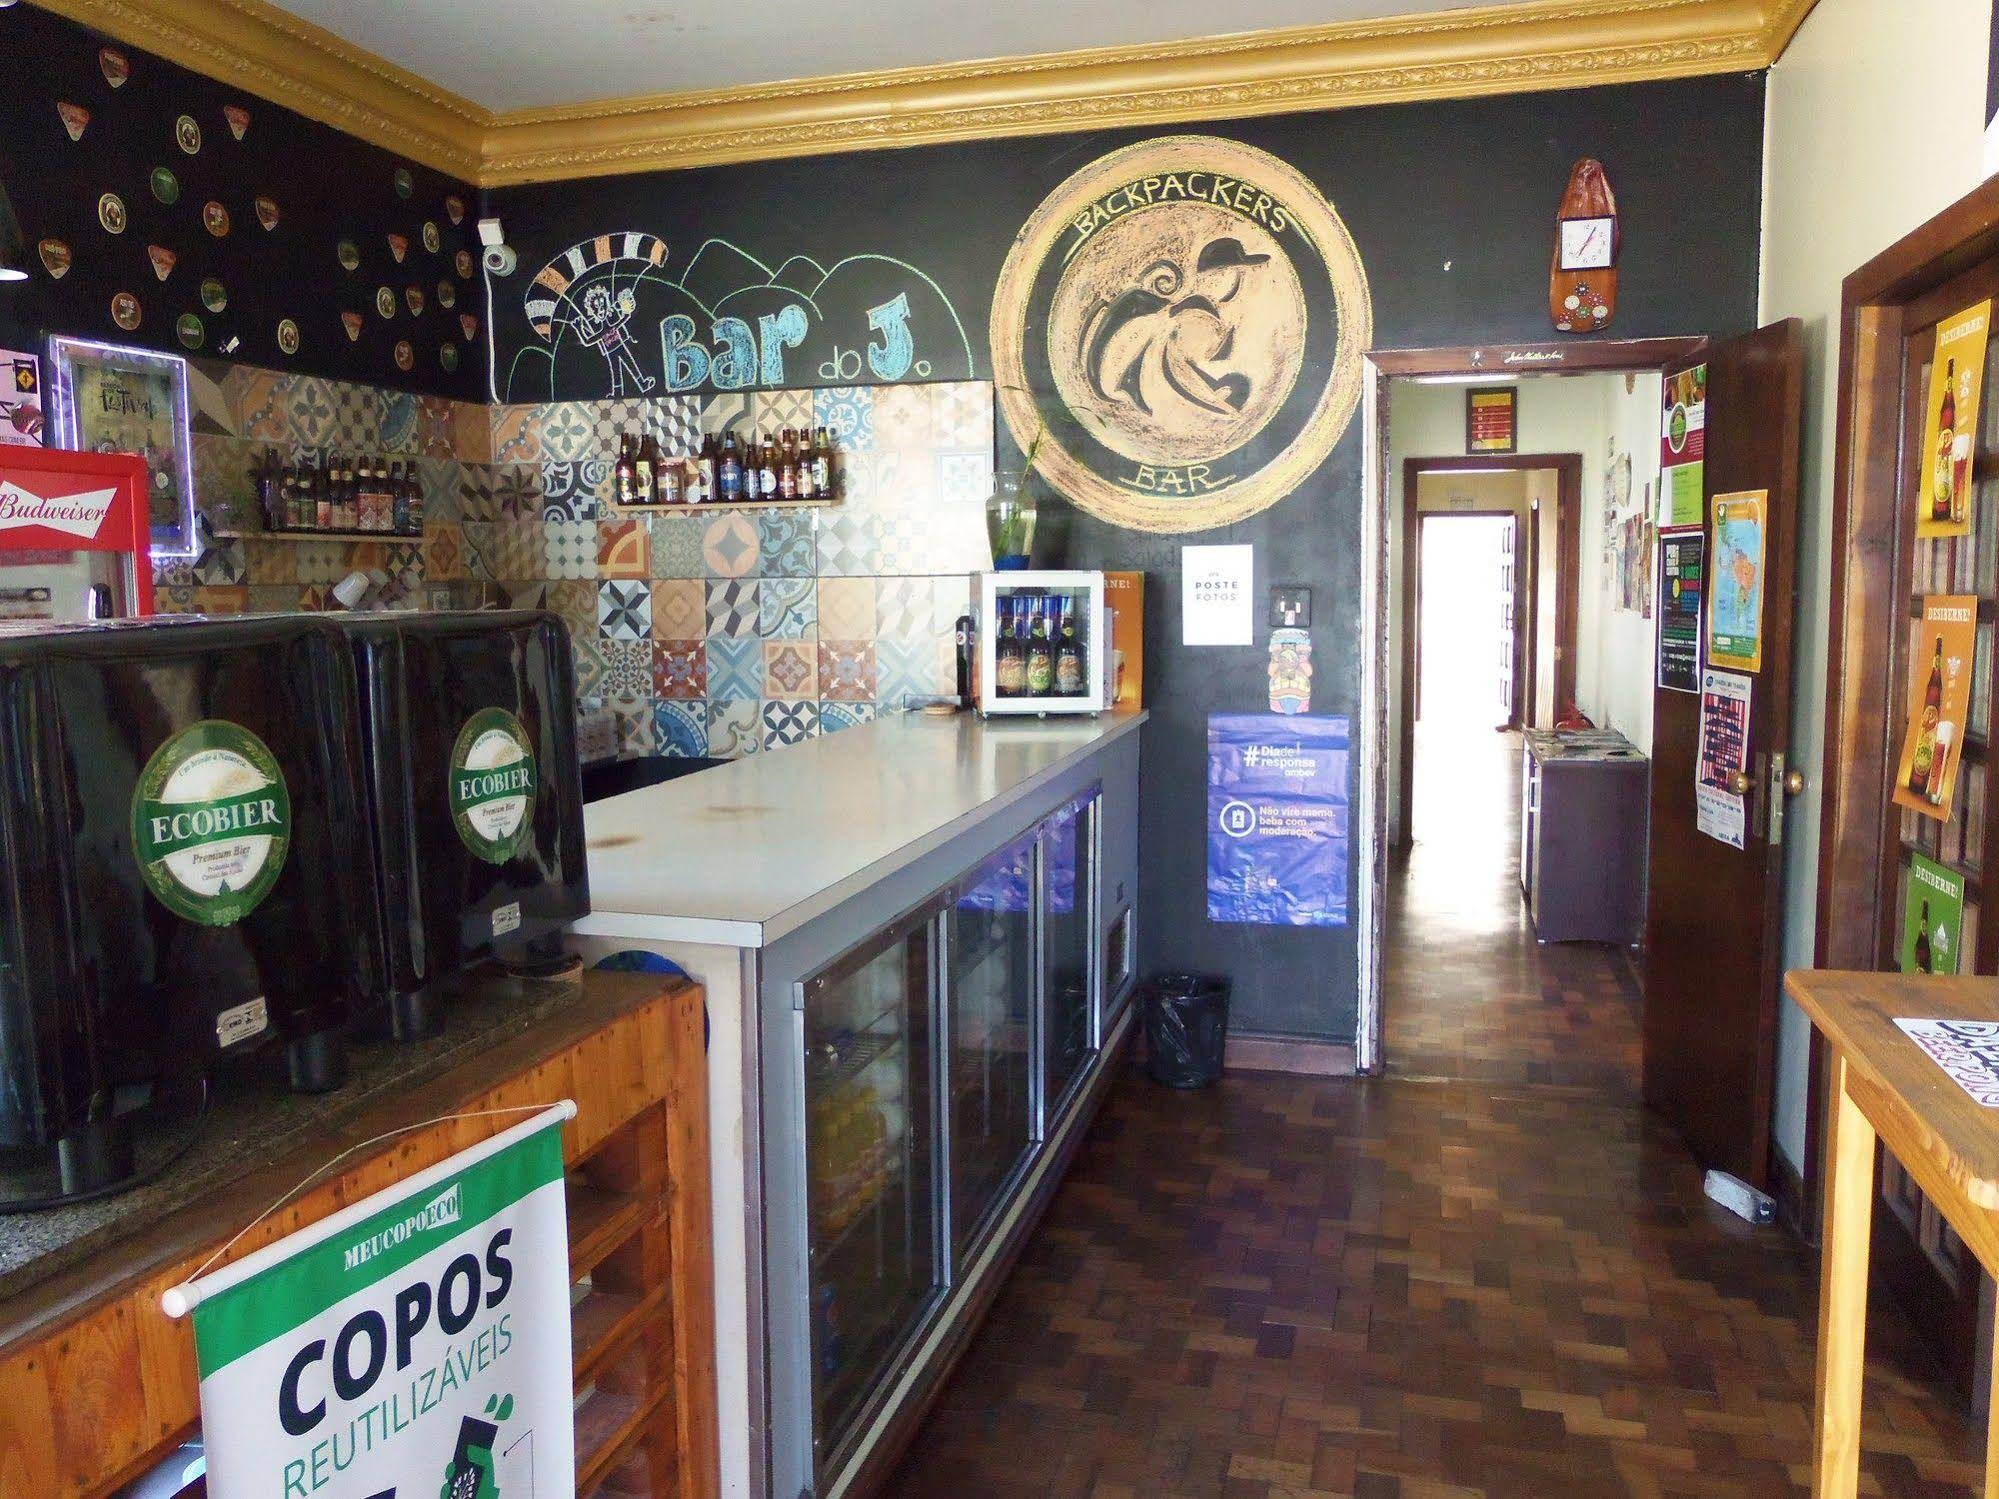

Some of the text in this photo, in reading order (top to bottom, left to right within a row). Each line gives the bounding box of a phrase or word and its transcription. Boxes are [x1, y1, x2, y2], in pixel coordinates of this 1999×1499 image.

[1073, 173, 1286, 235] BACKPACKERS
[660, 304, 808, 393] Bar
[818, 345, 861, 380] do
[1131, 464, 1218, 494] BAR
[0, 494, 106, 520] Budweiser
[1195, 581, 1238, 589] POSTE
[1196, 593, 1237, 601] FOTOS
[1928, 607, 1971, 622] DESIBERNE!
[1261, 758, 1316, 769] responsa
[460, 767, 533, 800] ECOBIER
[151, 799, 282, 844] ECOBIER
[1259, 806, 1279, 815] Não
[1259, 816, 1283, 825] beba
[1915, 865, 1958, 899] DESIBERNE!
[343, 1195, 457, 1272] MEUCOPOECO
[278, 1228, 513, 1436] COPOS
[284, 1313, 512, 1499] REUTILIZÁVEIS
